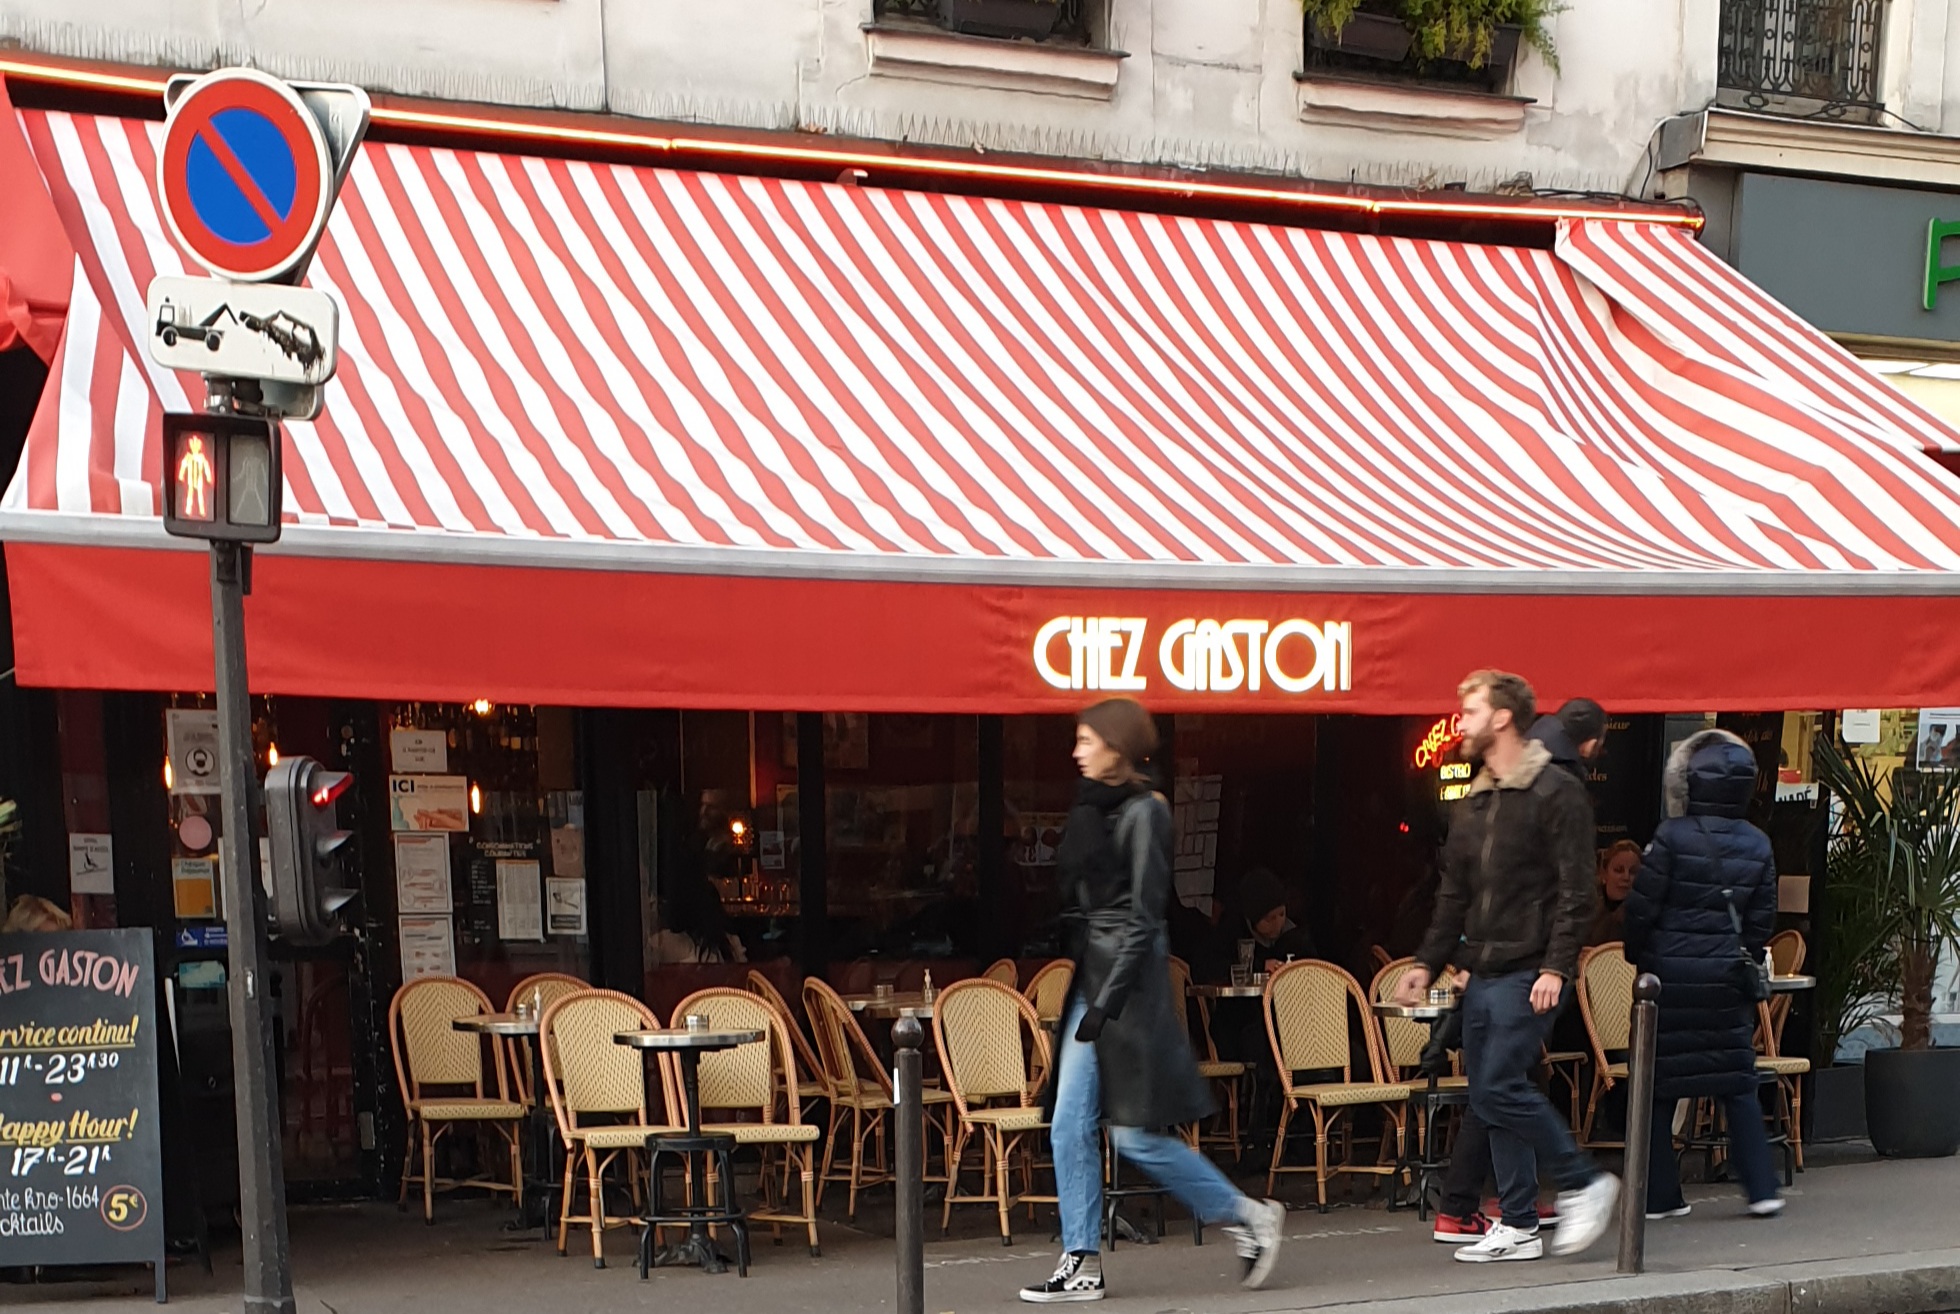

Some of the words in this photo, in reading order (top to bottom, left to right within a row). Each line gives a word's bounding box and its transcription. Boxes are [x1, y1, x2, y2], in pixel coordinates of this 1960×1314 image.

[1033, 616, 1147, 690] CHEZ
[1159, 618, 1352, 692] GASTON
[392, 779, 415, 793] ICI
[1440, 763, 1471, 779] BISTRO
[39, 948, 139, 998] GASTON
[58, 1014, 139, 1045] continu!
[69, 1107, 139, 1140] Hour!
